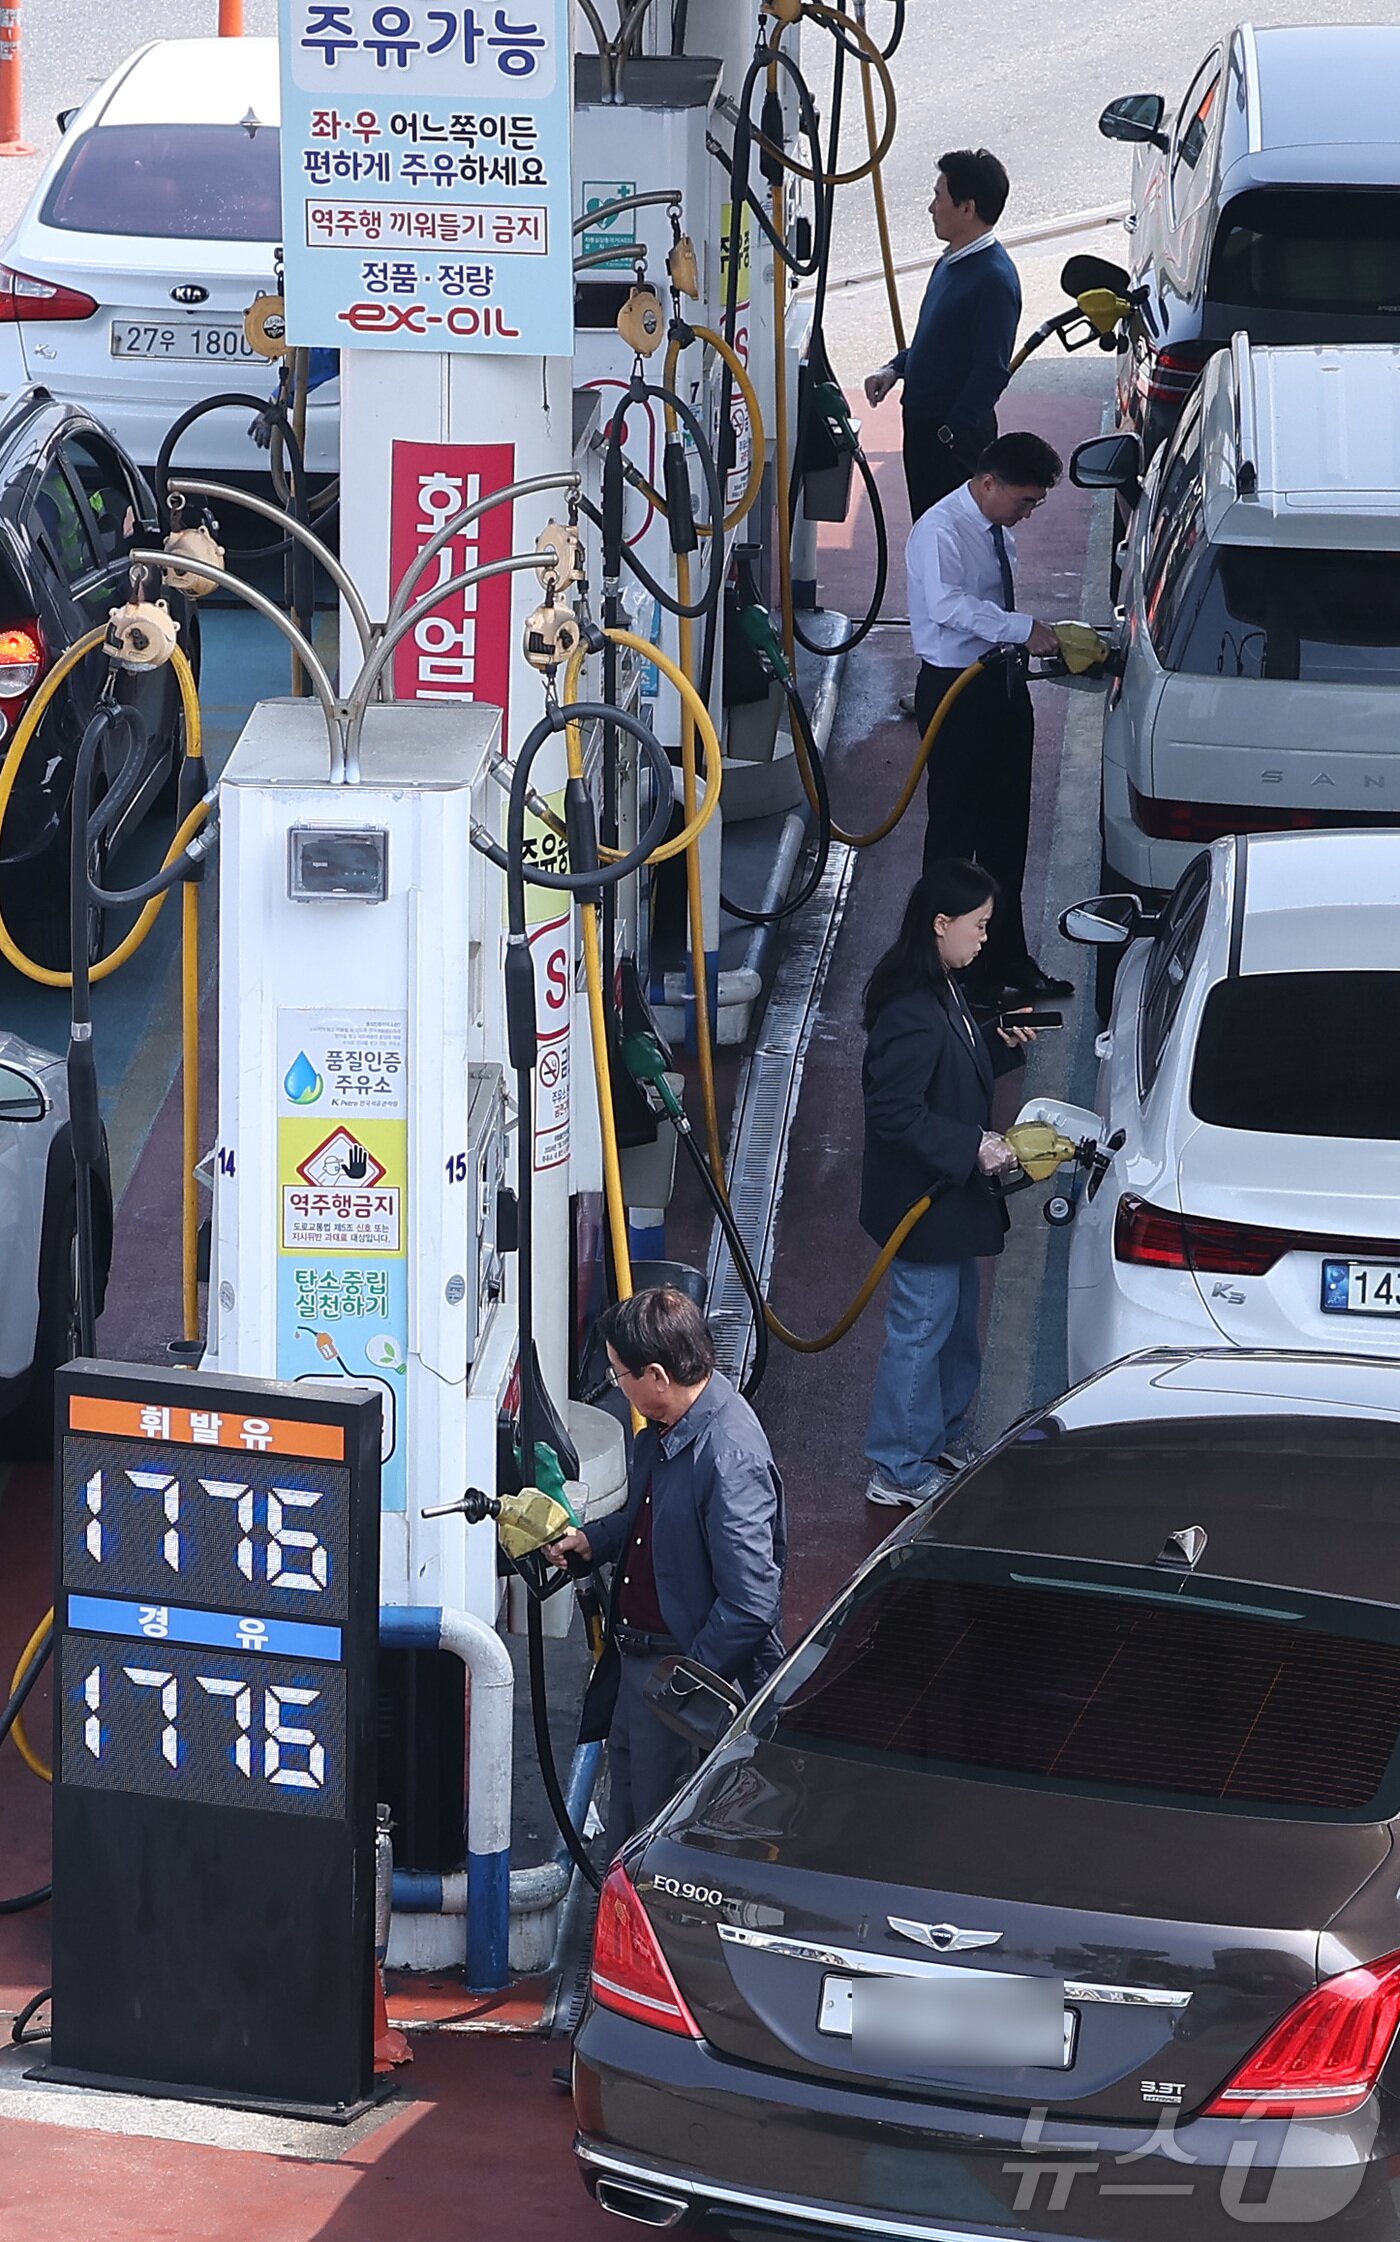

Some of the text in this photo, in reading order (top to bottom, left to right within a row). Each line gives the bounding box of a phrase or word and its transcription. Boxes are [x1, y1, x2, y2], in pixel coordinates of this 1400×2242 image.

[300, 5, 546, 76] 주유가능
[311, 110, 538, 151] 좌·우 어느쪽이든
[304, 150, 548, 188] 편하게 주유하세요
[311, 208, 539, 243] 역주행 끼워들기 금지
[175, 286, 203, 301] KIA
[126, 326, 254, 357] 27우 1800
[412, 472, 482, 702] 화기엄
[325, 1050, 402, 1073] 품질인증
[334, 1075, 392, 1095] 주유소
[218, 1147, 236, 1178] 14
[445, 1152, 467, 1184] 15
[290, 1193, 393, 1218] 역주행금지
[293, 1222, 331, 1232] 도로교통법
[295, 1269, 387, 1295] 탄소중립
[1211, 1281, 1247, 1305] K3
[1354, 1270, 1400, 1306] 14
[295, 1294, 387, 1318] 실천하기
[85, 1468, 329, 1592] 1776
[83, 1665, 326, 1789] 1776
[653, 1873, 723, 1907] EQ900
[1140, 2080, 1186, 2095] 3.3T
